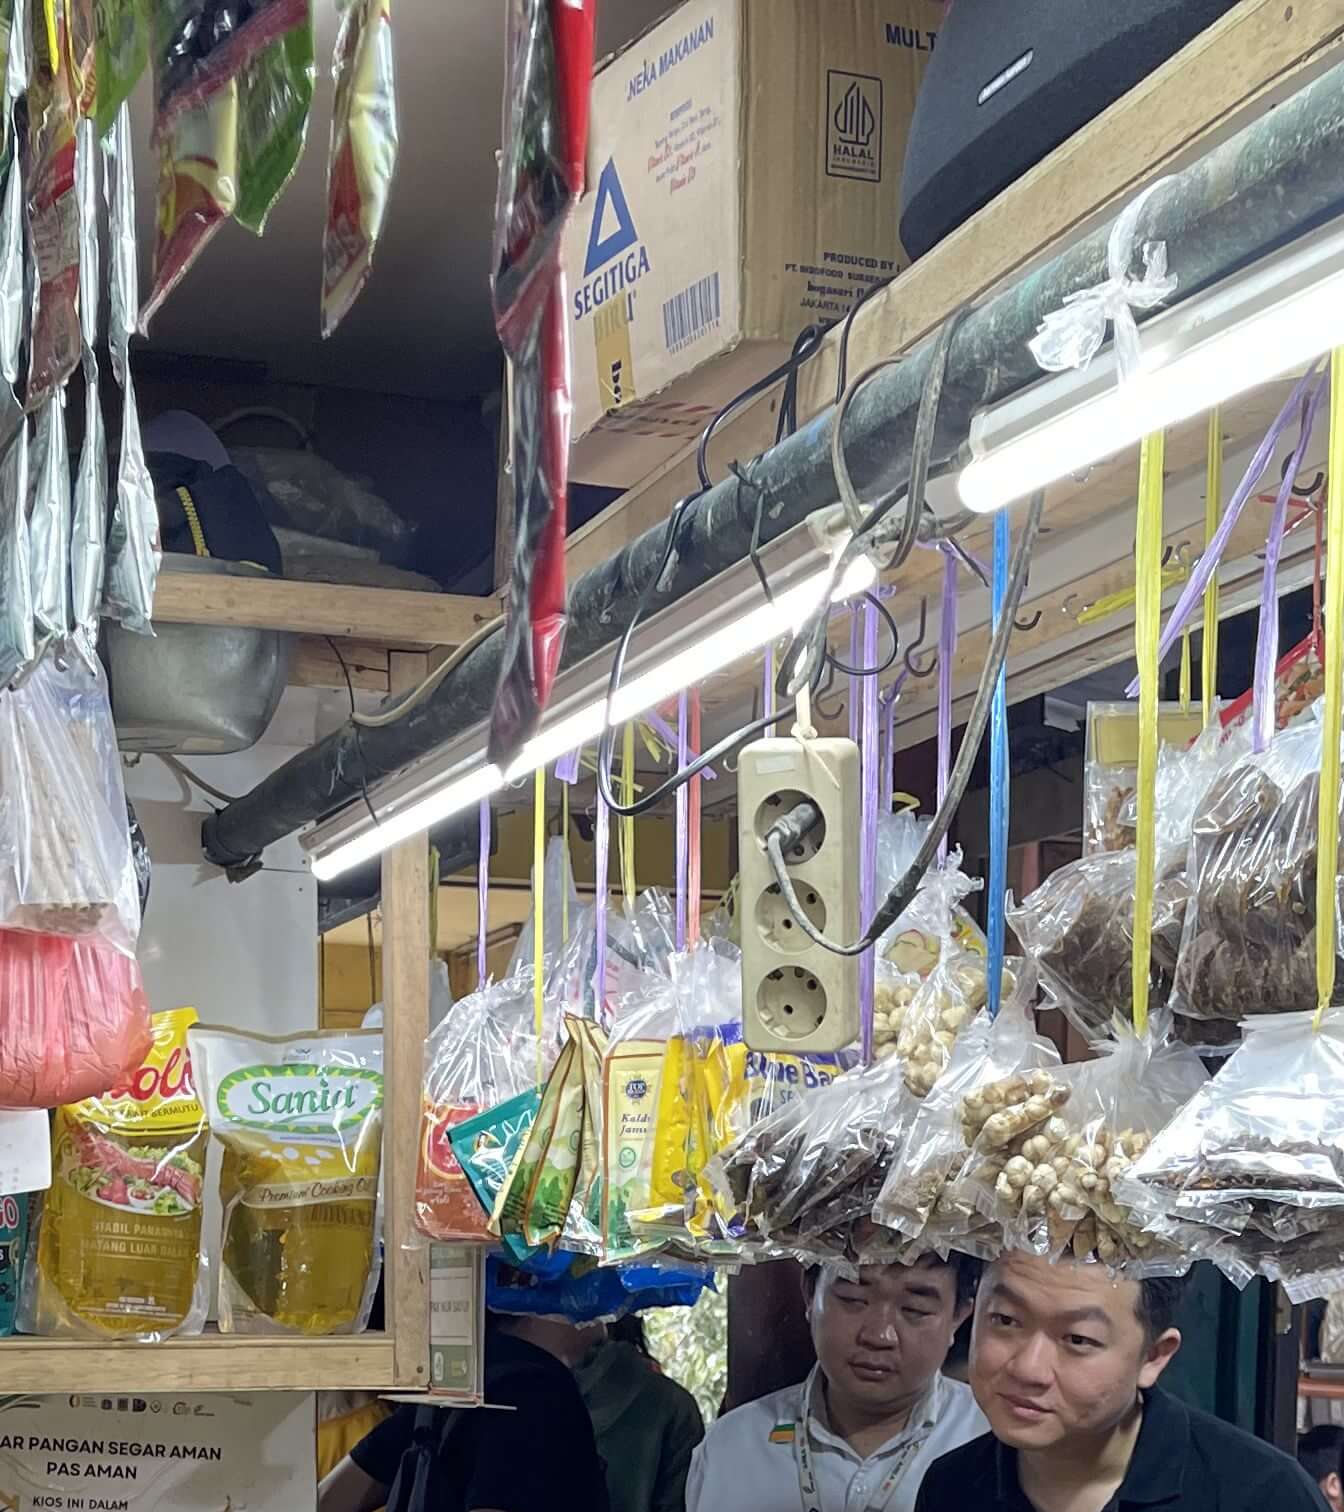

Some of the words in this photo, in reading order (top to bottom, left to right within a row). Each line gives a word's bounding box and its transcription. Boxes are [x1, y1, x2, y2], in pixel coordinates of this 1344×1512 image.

[658, 16, 714, 78] MAKANAN
[833, 144, 874, 160] HALAL
[823, 252, 878, 269] PRODUCED
[879, 261, 895, 271] BY
[574, 245, 651, 321] SEGITIGA
[800, 297, 839, 313] JAKARTA
[248, 1077, 356, 1116] Sania
[151, 1103, 199, 1119] BERMUTU
[261, 1186, 308, 1201] Premium
[310, 1180, 355, 1198] Cooking
[28, 1436, 104, 1455] PANGAN
[107, 1441, 167, 1458] SEGAR
[169, 1445, 222, 1461] AMAN
[46, 1461, 80, 1477] PAS
[84, 1463, 138, 1480] AMAN
[32, 1495, 63, 1508] KIOS
[67, 1498, 84, 1509] INI
[88, 1499, 129, 1511] DALAM
